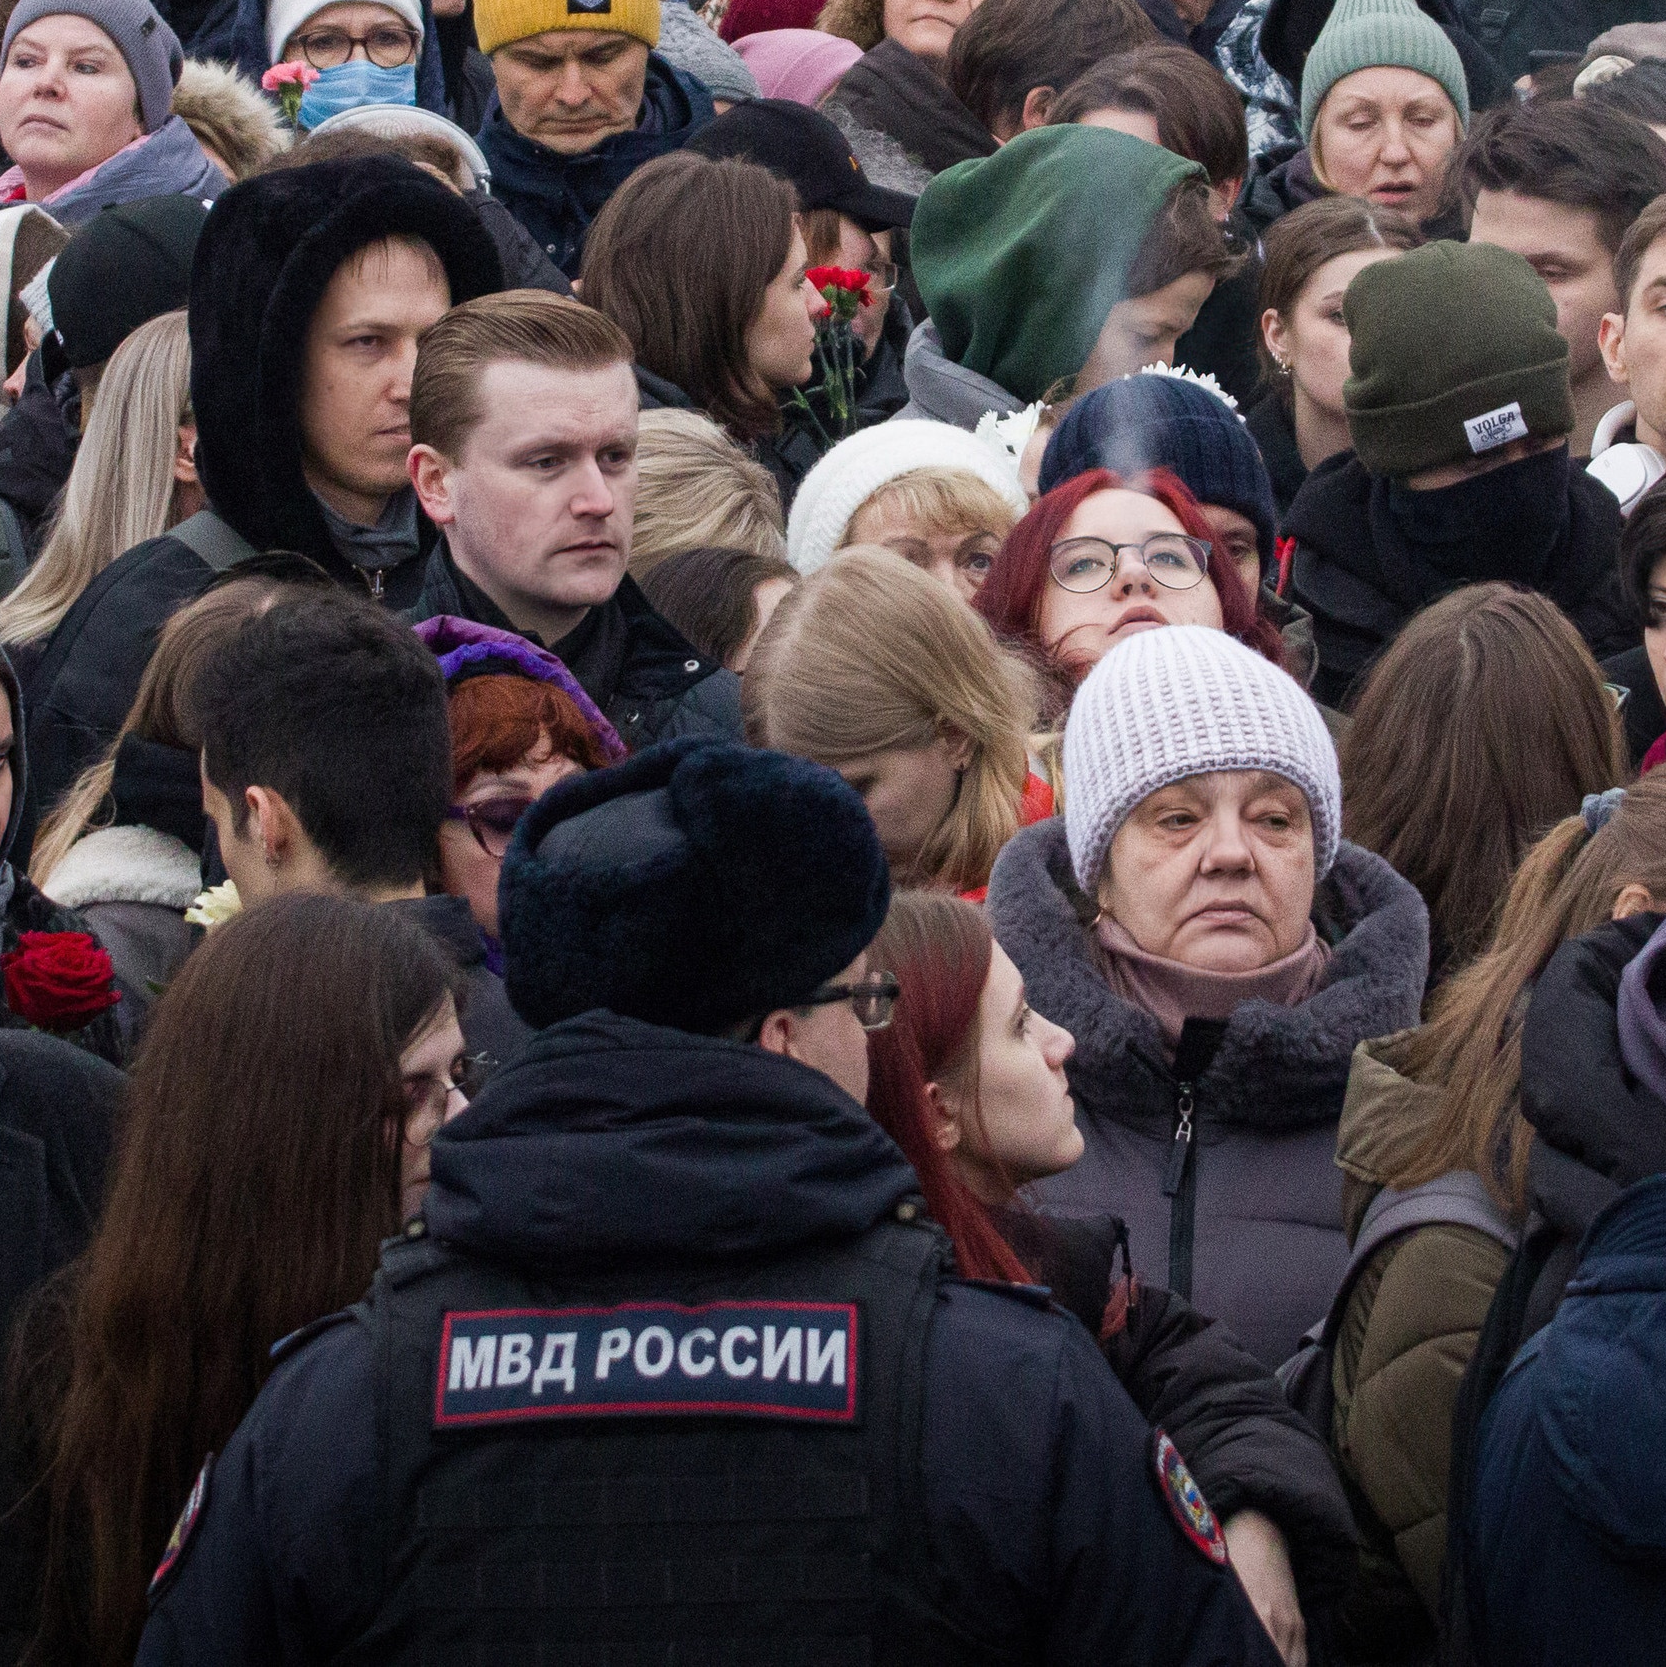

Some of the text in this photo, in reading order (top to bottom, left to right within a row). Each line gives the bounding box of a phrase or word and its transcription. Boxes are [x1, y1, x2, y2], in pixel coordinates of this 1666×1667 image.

[1472, 411, 1517, 435] VOLGA
[448, 1325, 847, 1395] МВД РОССИИ
